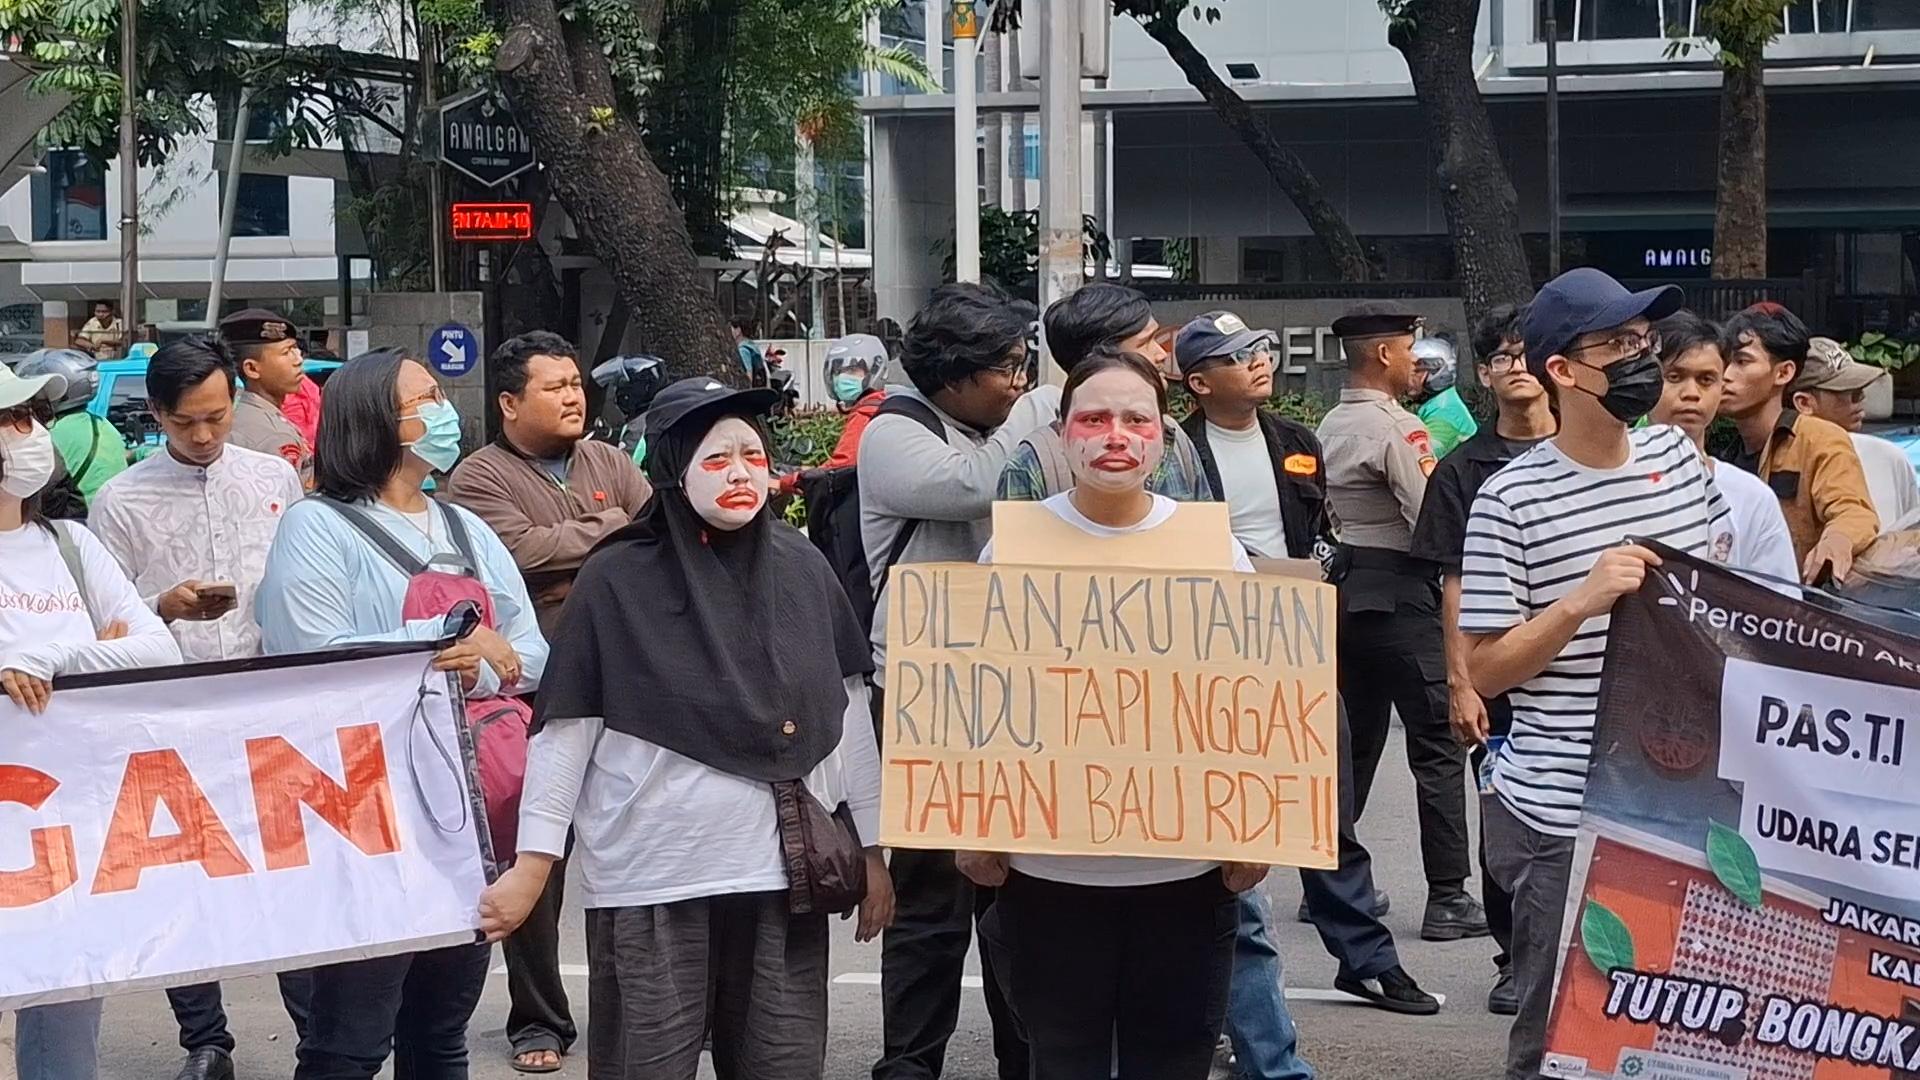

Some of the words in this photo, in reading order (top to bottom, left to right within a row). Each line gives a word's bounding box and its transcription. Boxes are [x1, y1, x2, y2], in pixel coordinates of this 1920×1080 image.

[450, 122, 529, 152] AMALGAM
[1645, 248, 1712, 266] AMALG
[1689, 597, 1864, 658] Persatuan
[895, 661, 1044, 754] RINDU,
[1046, 667, 1151, 752] TAPI
[1172, 670, 1328, 763] NGGAK
[890, 758, 1058, 840] TAHAN
[1085, 764, 1185, 844] BAU
[1757, 803, 1862, 862] UDARA
[1606, 970, 1745, 1033] TUTUP
